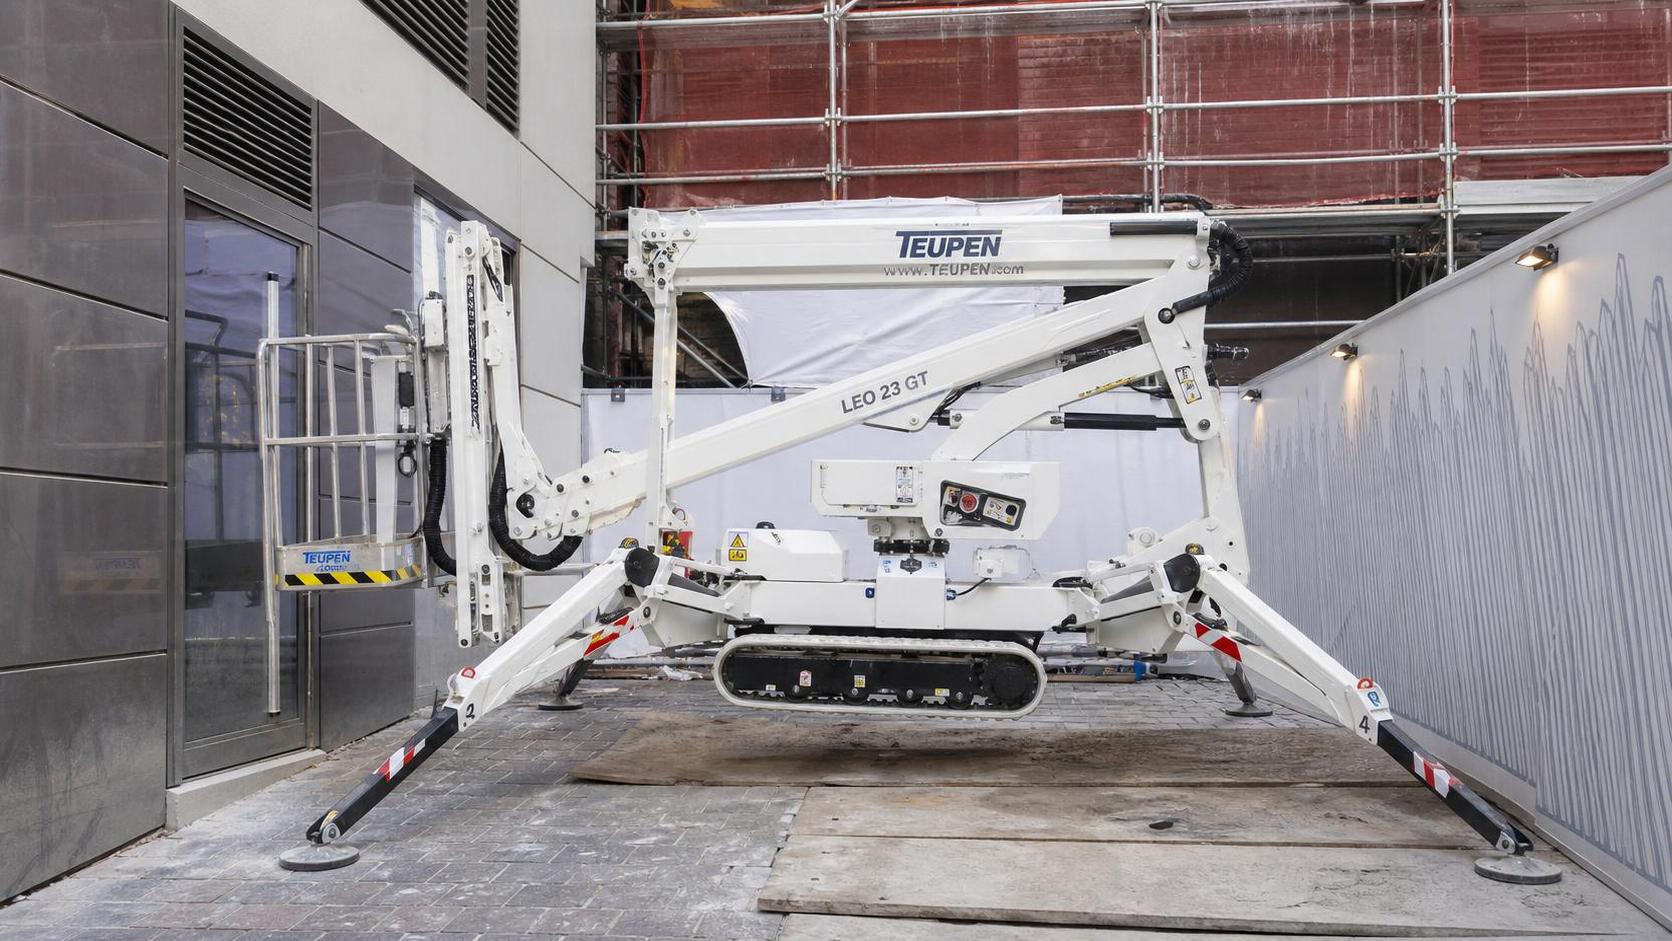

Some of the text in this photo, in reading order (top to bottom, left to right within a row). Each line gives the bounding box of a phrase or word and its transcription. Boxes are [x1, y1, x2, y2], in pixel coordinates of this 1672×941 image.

[896, 229, 1002, 258] TEUPEN
[841, 370, 928, 414] LEO 23 GT
[303, 550, 351, 564] TEUPEN
[466, 703, 475, 719] 2
[1359, 715, 1370, 734] 4
